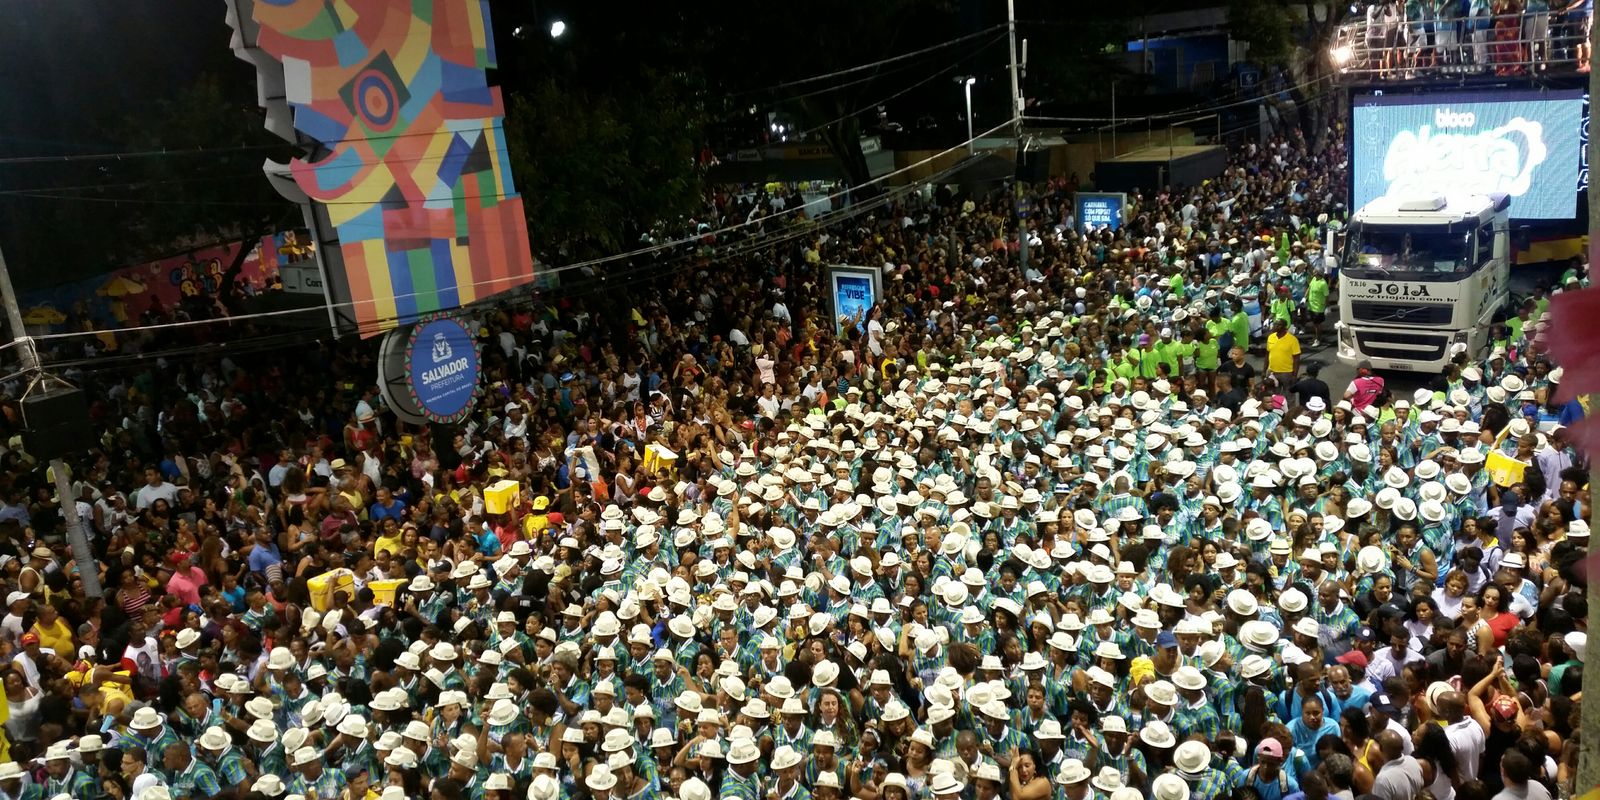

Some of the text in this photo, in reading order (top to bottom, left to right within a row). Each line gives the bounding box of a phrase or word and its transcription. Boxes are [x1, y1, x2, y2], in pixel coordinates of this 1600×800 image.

[1435, 108, 1476, 127] bloco
[845, 289, 865, 300] VIBE
[1347, 293, 1457, 303] www.triojoia.com.br
[422, 357, 469, 385] SALVADOR
[430, 373, 465, 391] PREFEITURA
